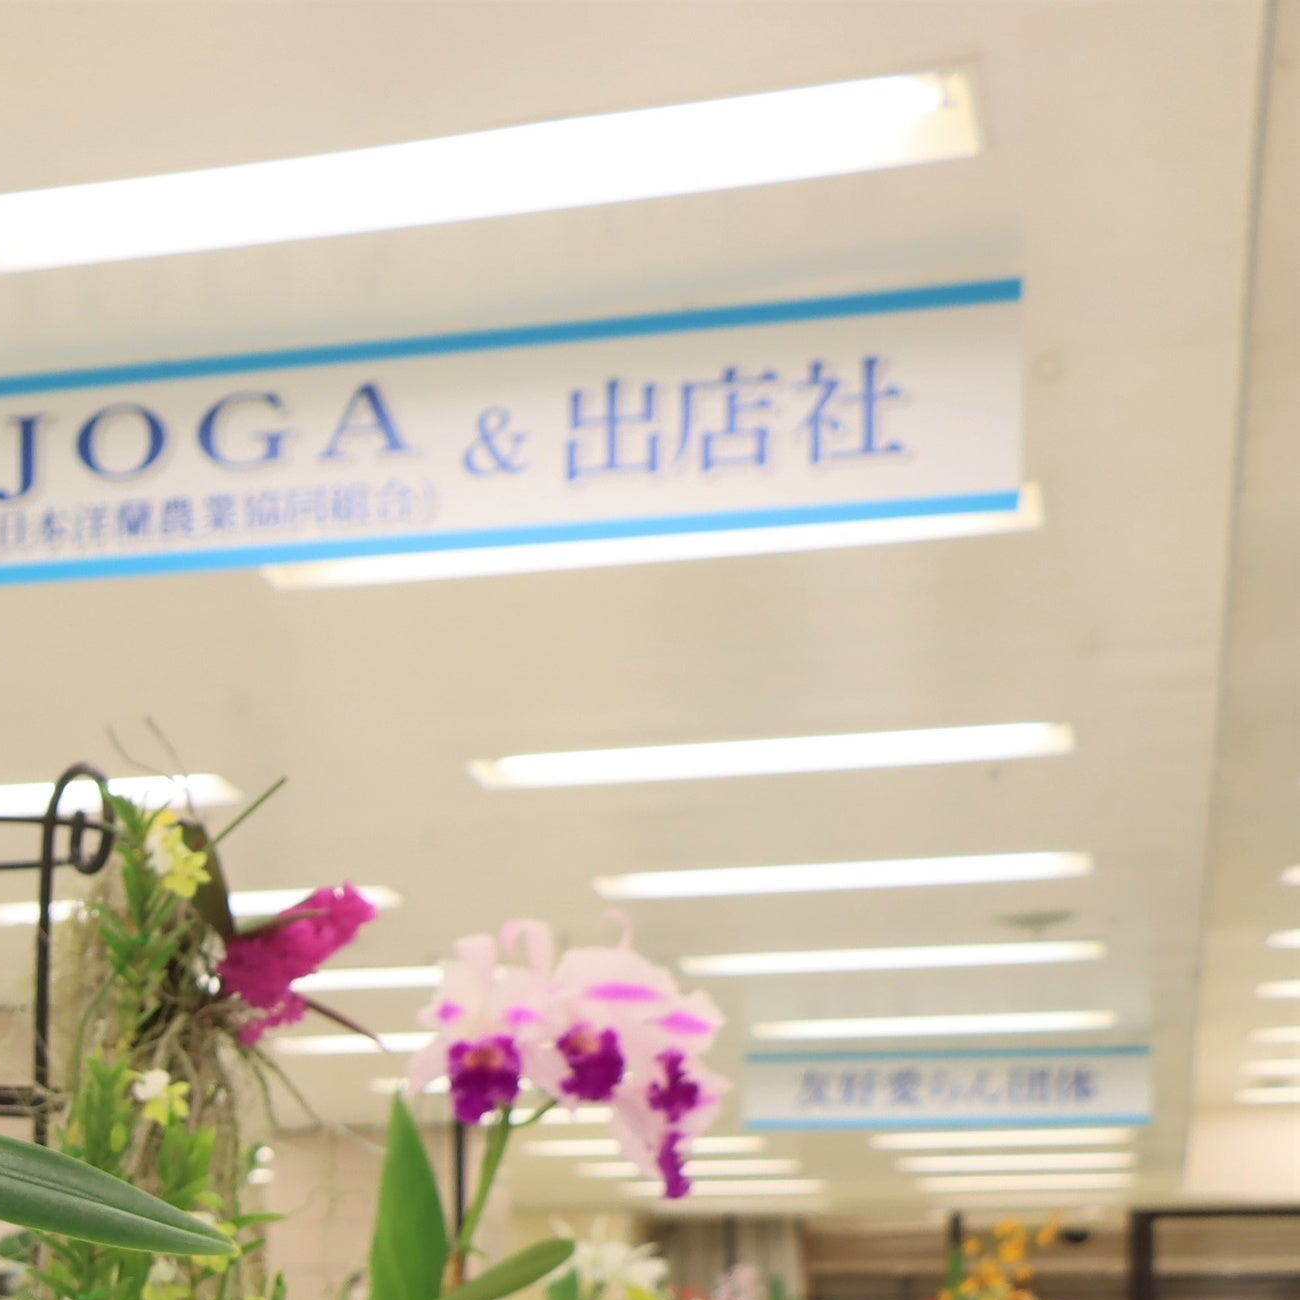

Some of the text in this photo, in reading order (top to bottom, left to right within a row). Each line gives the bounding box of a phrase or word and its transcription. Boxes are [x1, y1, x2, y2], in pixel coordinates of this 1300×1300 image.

[461, 404, 531, 478] &
[565, 354, 906, 482] 出店社
